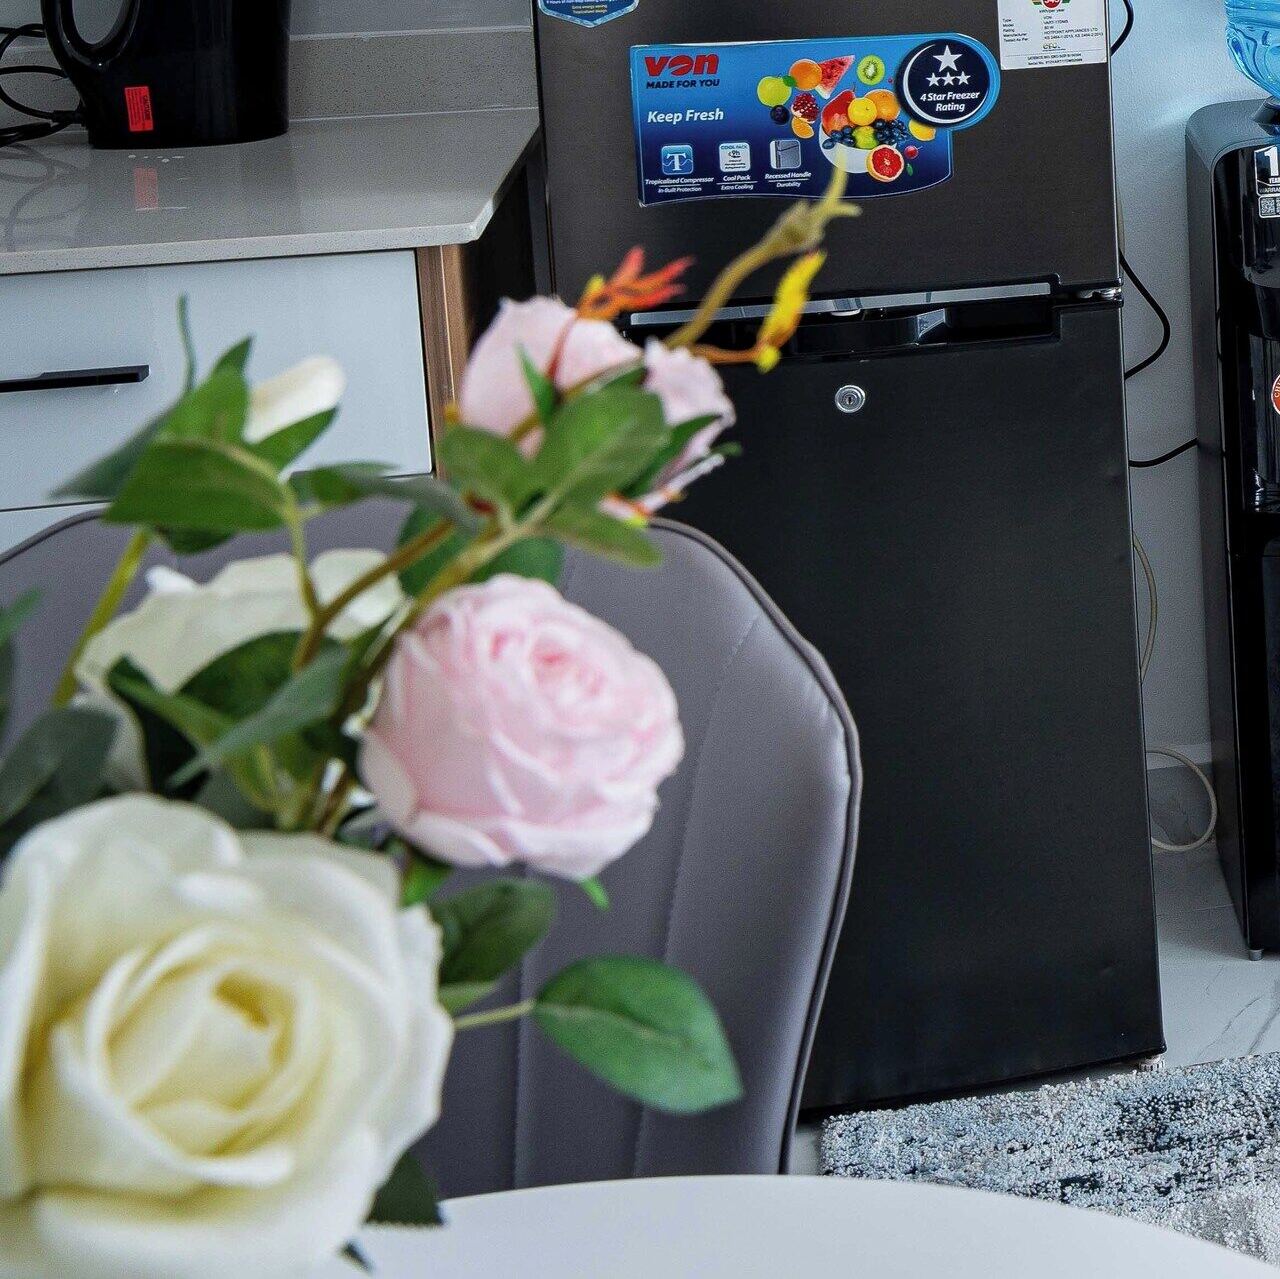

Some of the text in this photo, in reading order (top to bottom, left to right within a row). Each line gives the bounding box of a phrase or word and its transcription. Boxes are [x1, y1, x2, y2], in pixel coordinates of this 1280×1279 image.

[646, 79, 720, 89] MADE FOR YOU
[920, 92, 980, 102] 4 Star Freezer
[935, 102, 965, 112] Rating
[647, 108, 724, 125] Keep Fresh
[1264, 146, 1279, 176] 1
